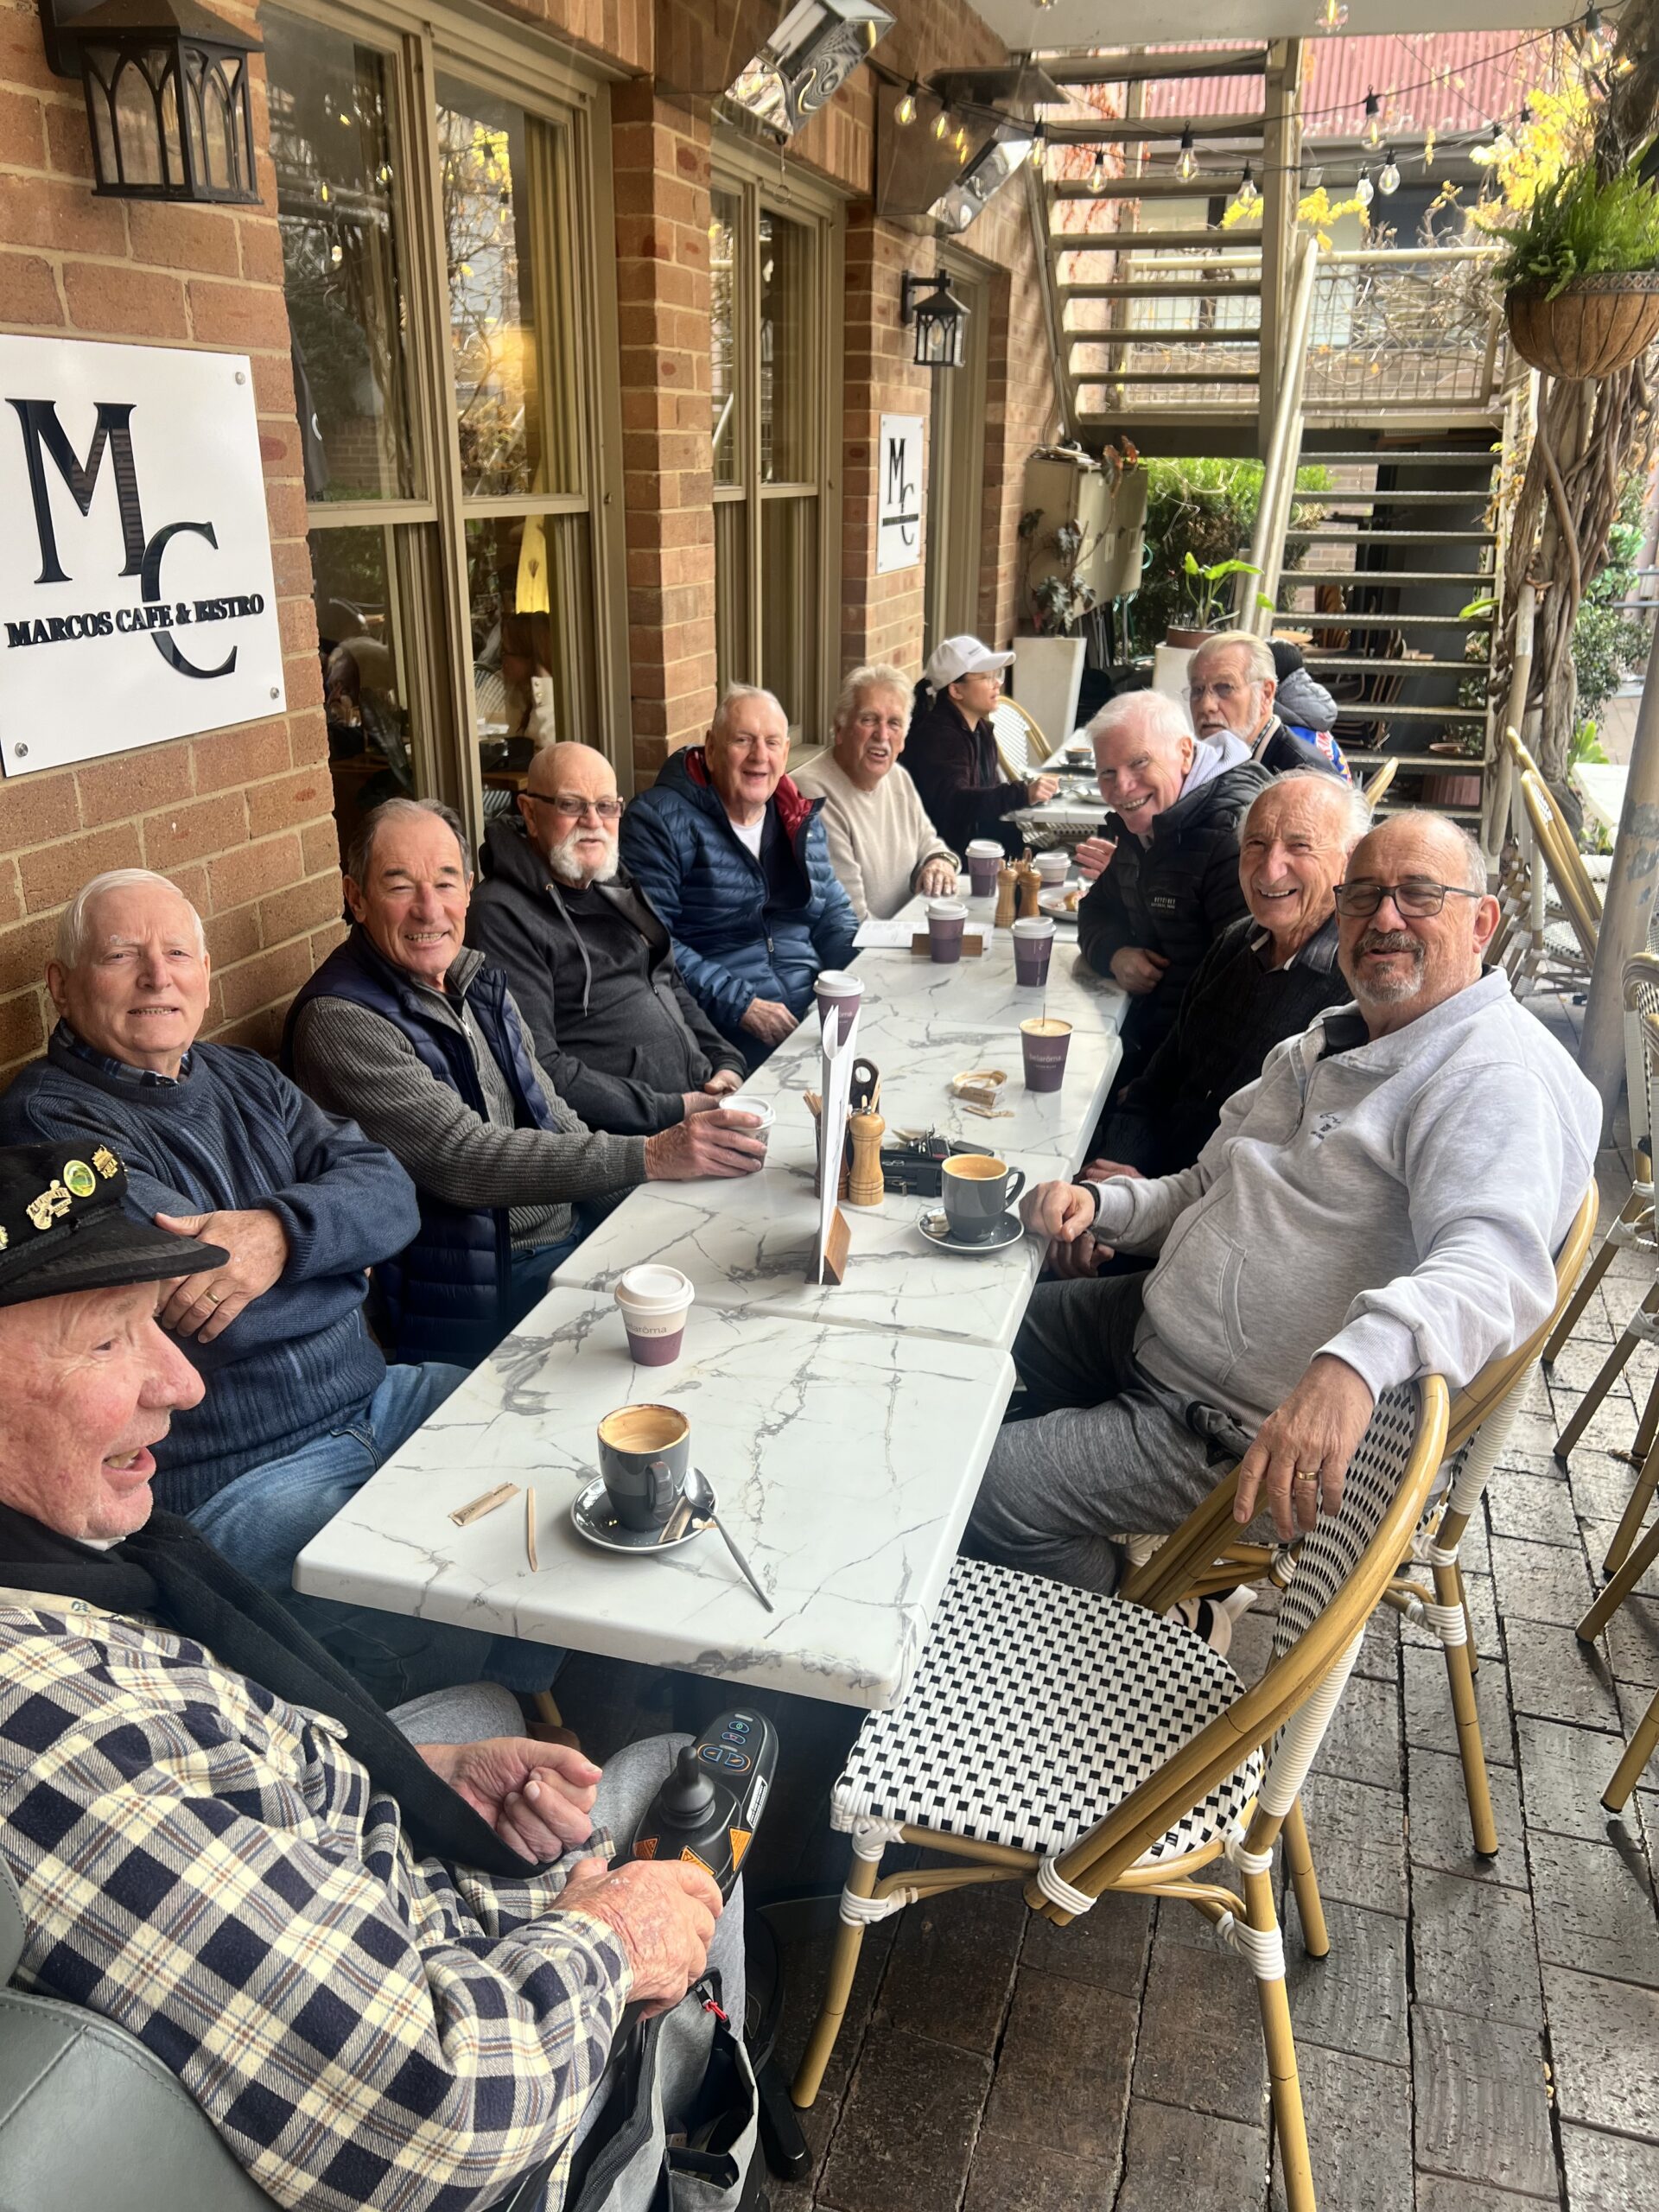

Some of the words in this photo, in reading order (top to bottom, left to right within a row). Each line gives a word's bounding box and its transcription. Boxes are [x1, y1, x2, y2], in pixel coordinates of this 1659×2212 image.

[5, 611, 114, 648] MARCOS
[116, 605, 174, 632] CAFE
[175, 602, 193, 625] &
[193, 594, 265, 623] BISTRO
